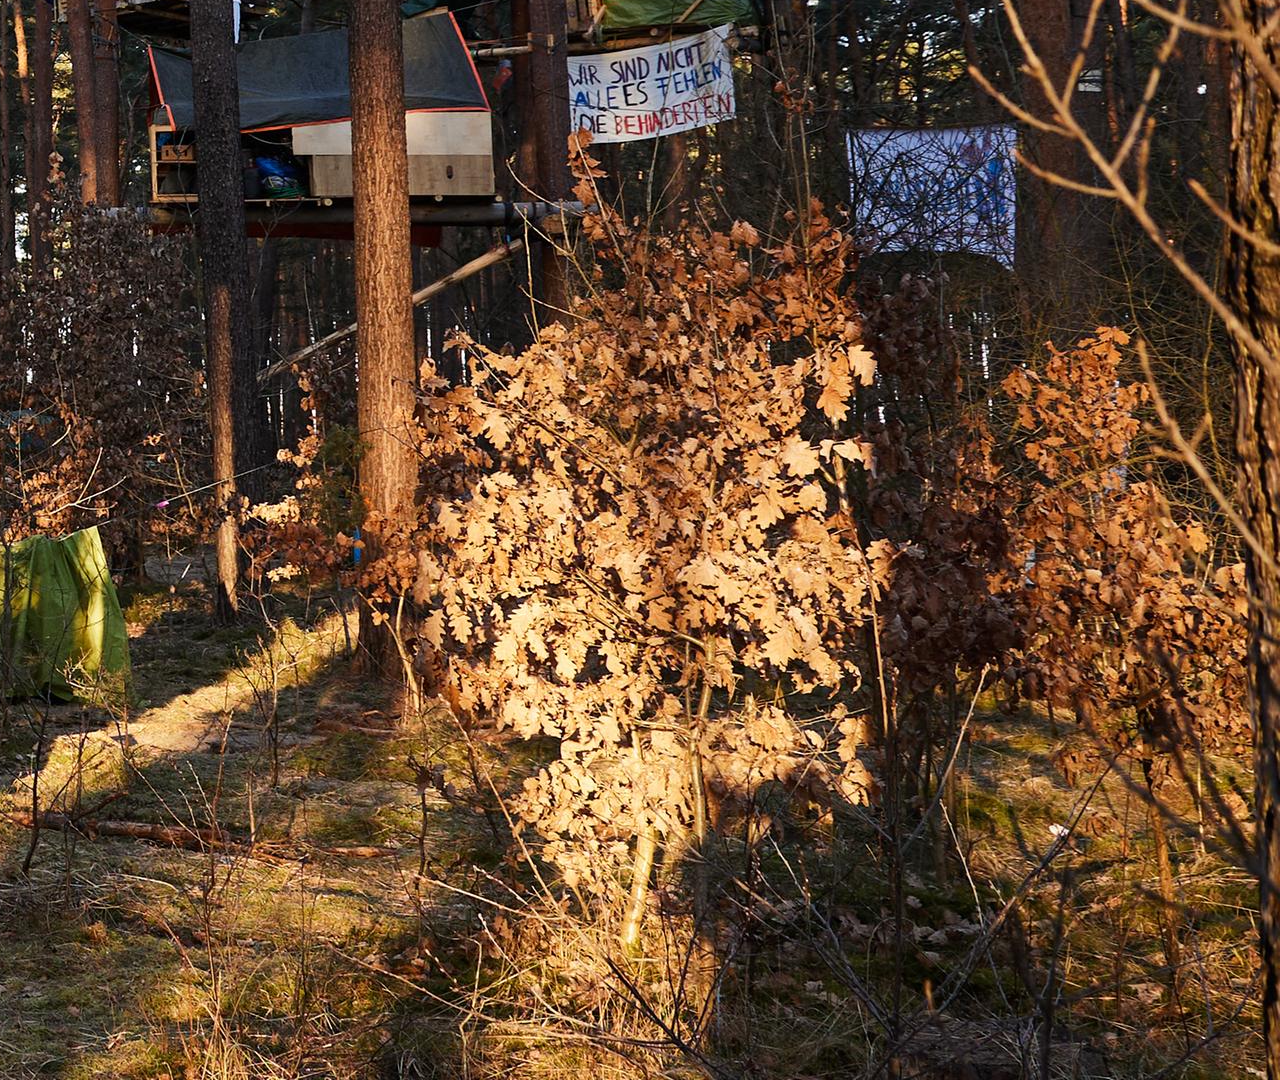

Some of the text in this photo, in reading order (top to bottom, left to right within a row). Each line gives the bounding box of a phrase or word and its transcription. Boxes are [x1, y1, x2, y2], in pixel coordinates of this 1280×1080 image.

[569, 42, 705, 86] WIR SIND NICHT
[655, 59, 722, 97] FEHLEN
[615, 93, 732, 136] BEHINDERTEN
